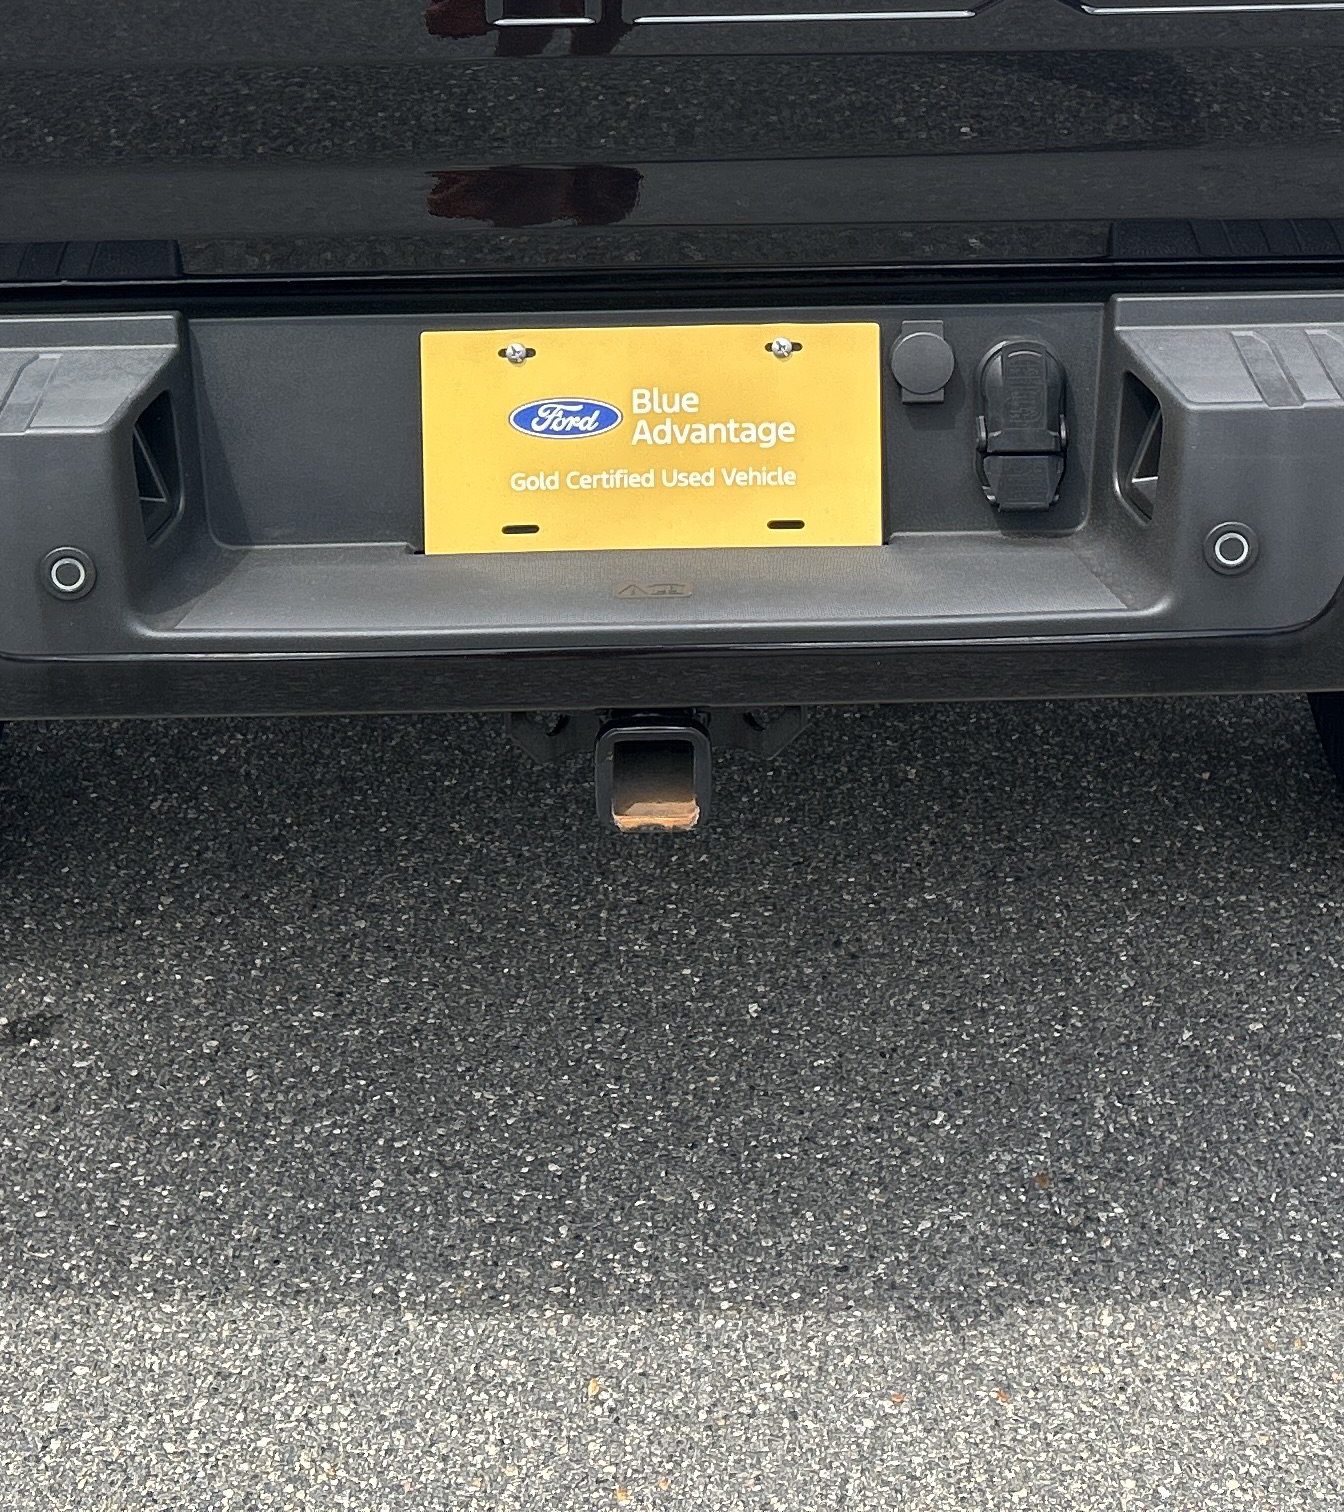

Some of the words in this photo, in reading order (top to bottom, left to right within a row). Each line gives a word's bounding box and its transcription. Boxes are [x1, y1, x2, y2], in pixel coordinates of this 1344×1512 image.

[530, 402, 600, 434] Ford
[631, 387, 700, 414] Blue
[631, 417, 797, 449] Advantage
[510, 470, 560, 492] Gold
[565, 468, 655, 491] Certified
[660, 468, 716, 488] Used
[720, 466, 798, 488] Vehicle
